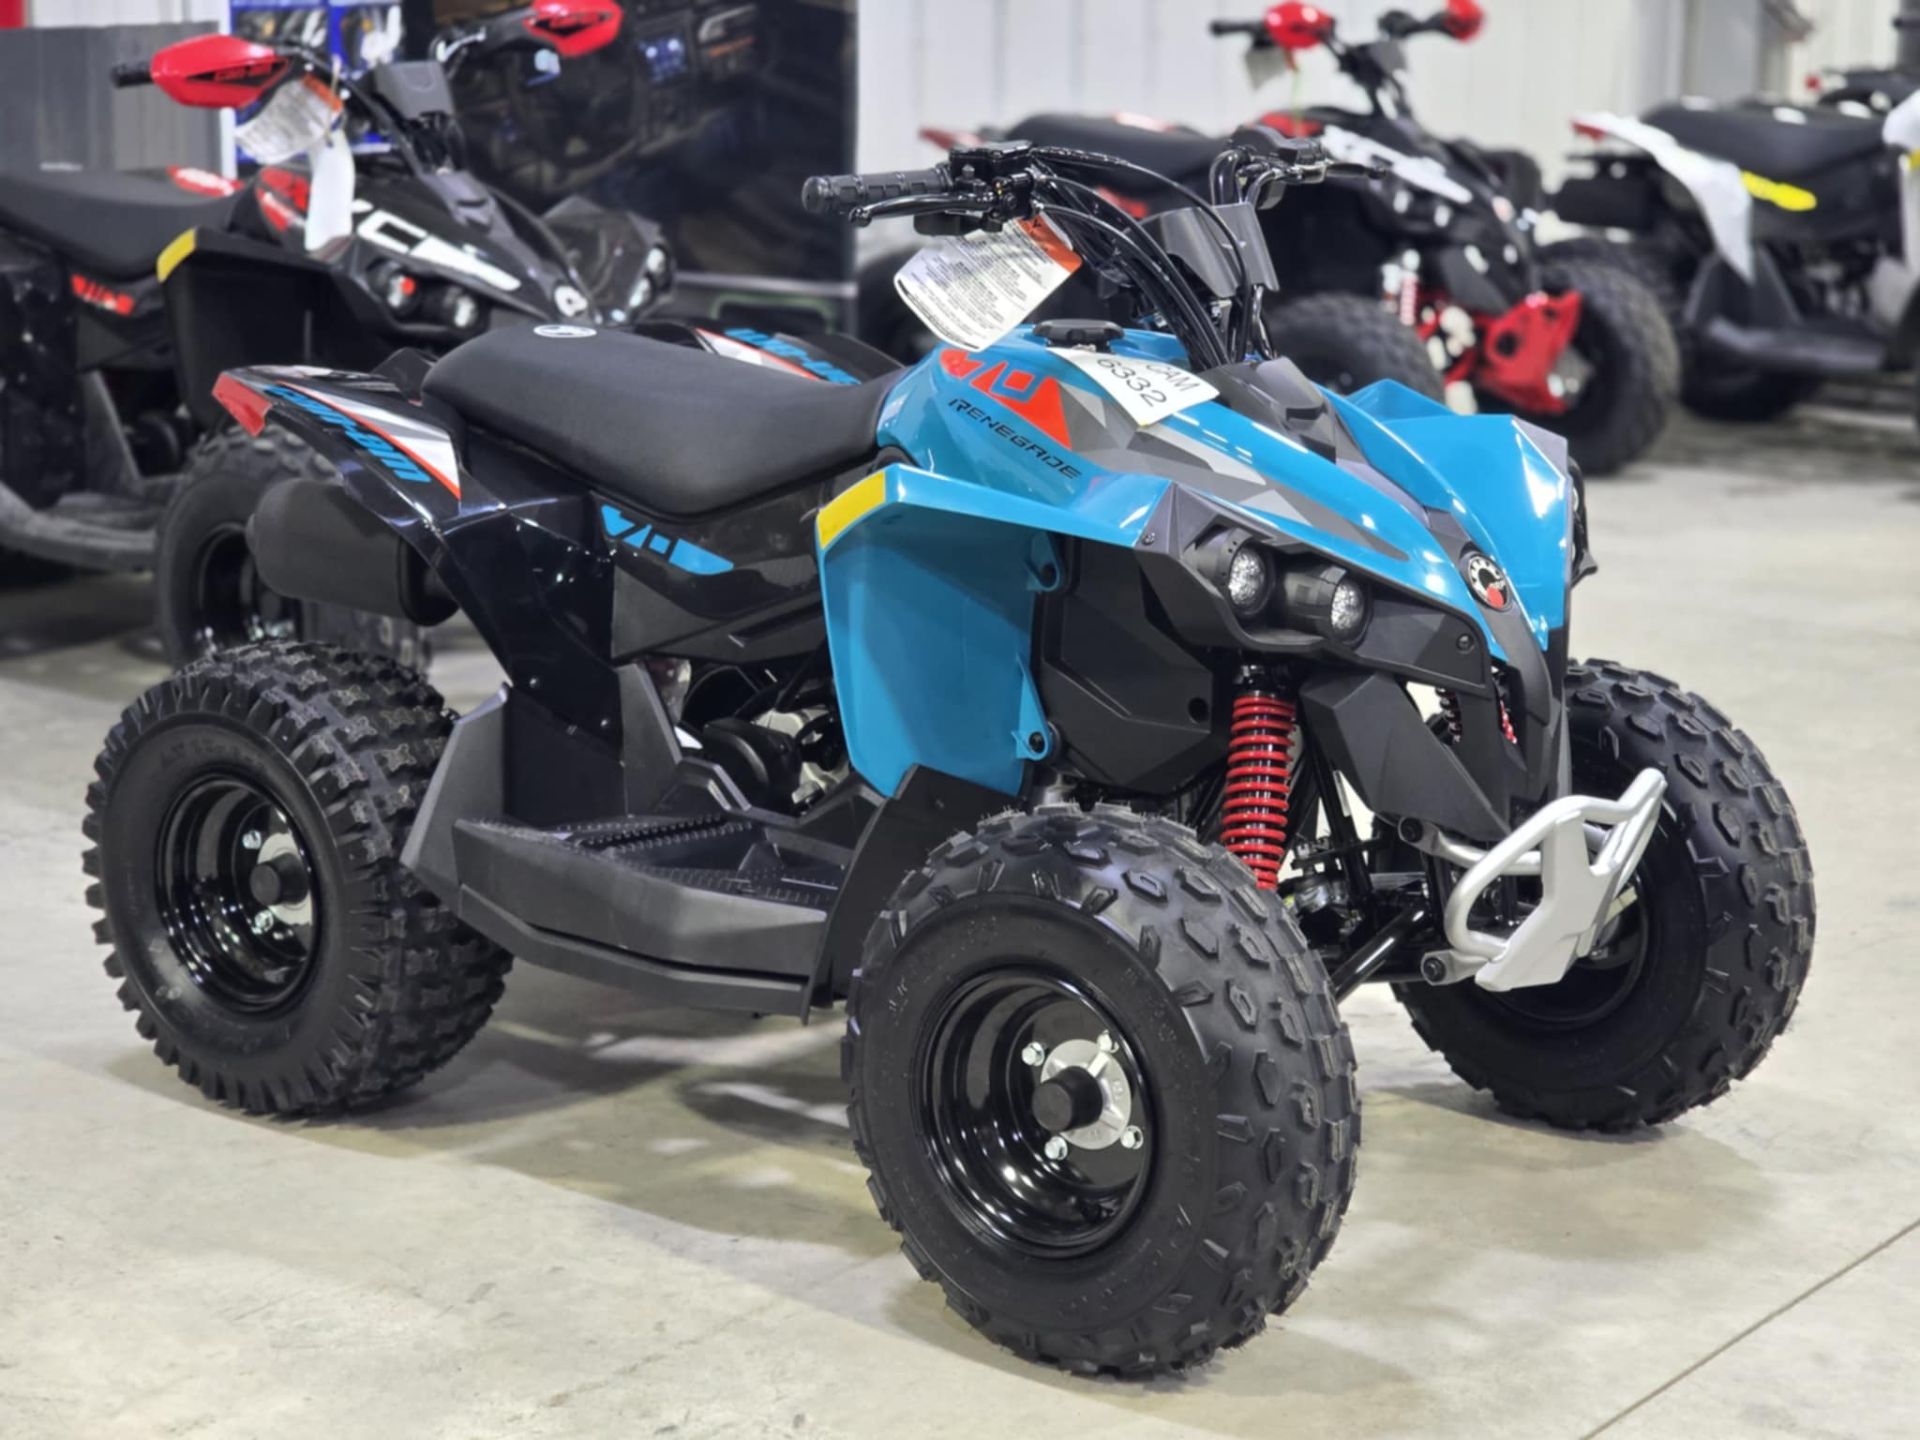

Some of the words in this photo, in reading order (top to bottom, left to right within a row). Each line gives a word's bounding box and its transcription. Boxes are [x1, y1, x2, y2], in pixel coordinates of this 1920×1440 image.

[1097, 357, 1168, 407] 6332
[1146, 364, 1201, 393] CAM
[948, 398, 1083, 480] RENEGADE
